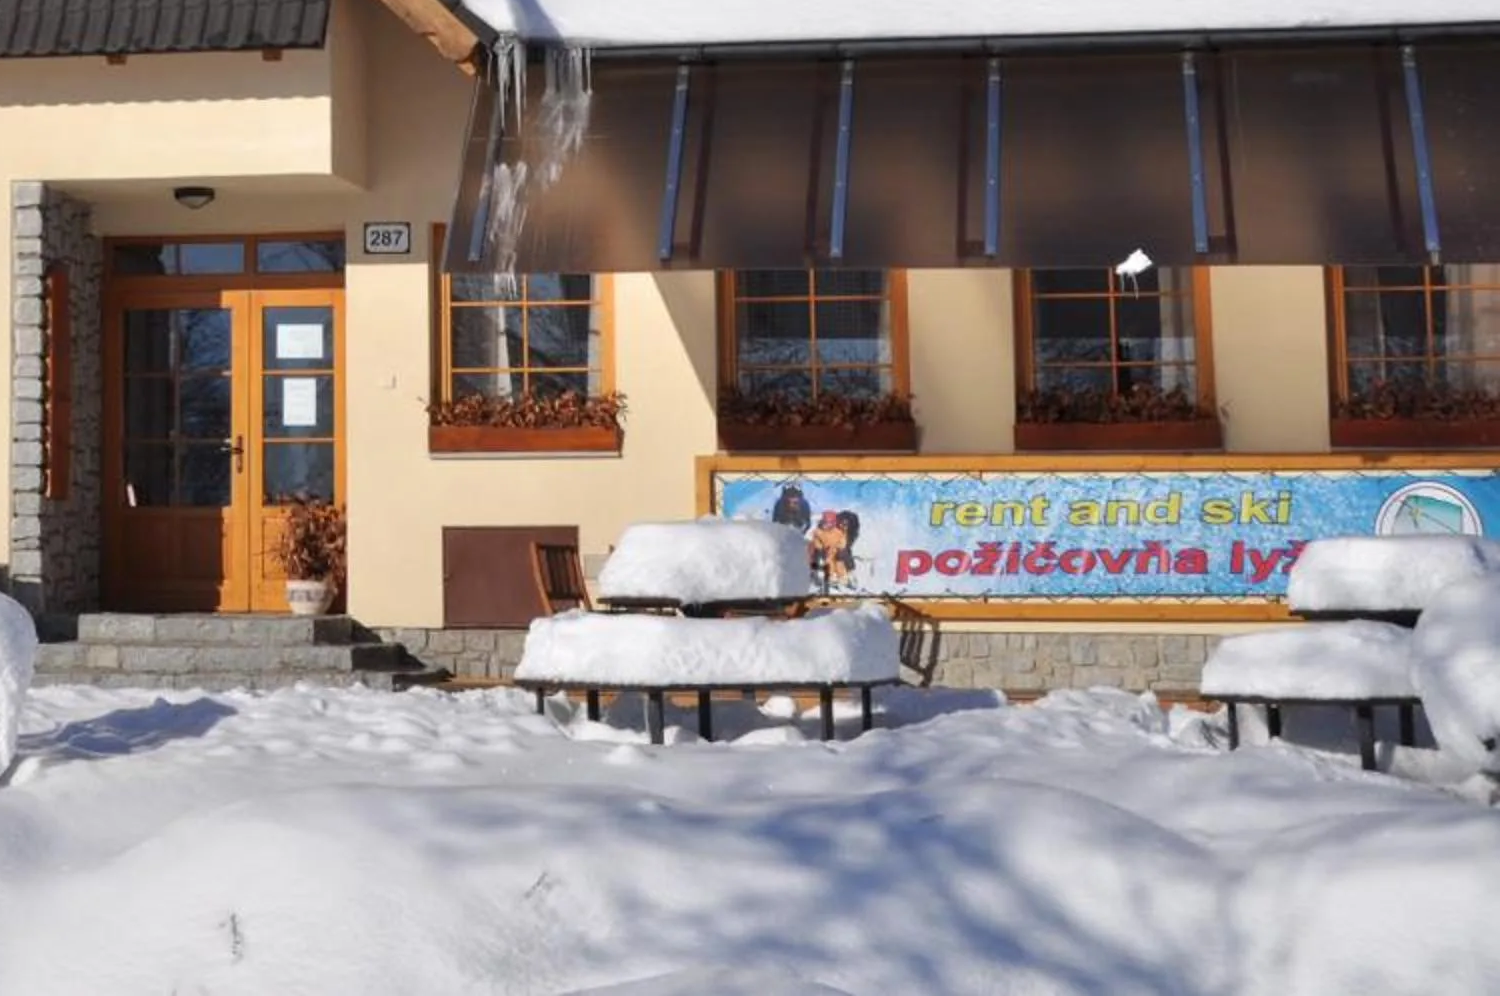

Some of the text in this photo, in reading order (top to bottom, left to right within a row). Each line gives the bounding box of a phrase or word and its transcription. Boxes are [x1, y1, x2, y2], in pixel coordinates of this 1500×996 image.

[370, 230, 404, 247] 287
[929, 490, 1292, 527] rent and ski
[895, 540, 1208, 584] požičovňa
